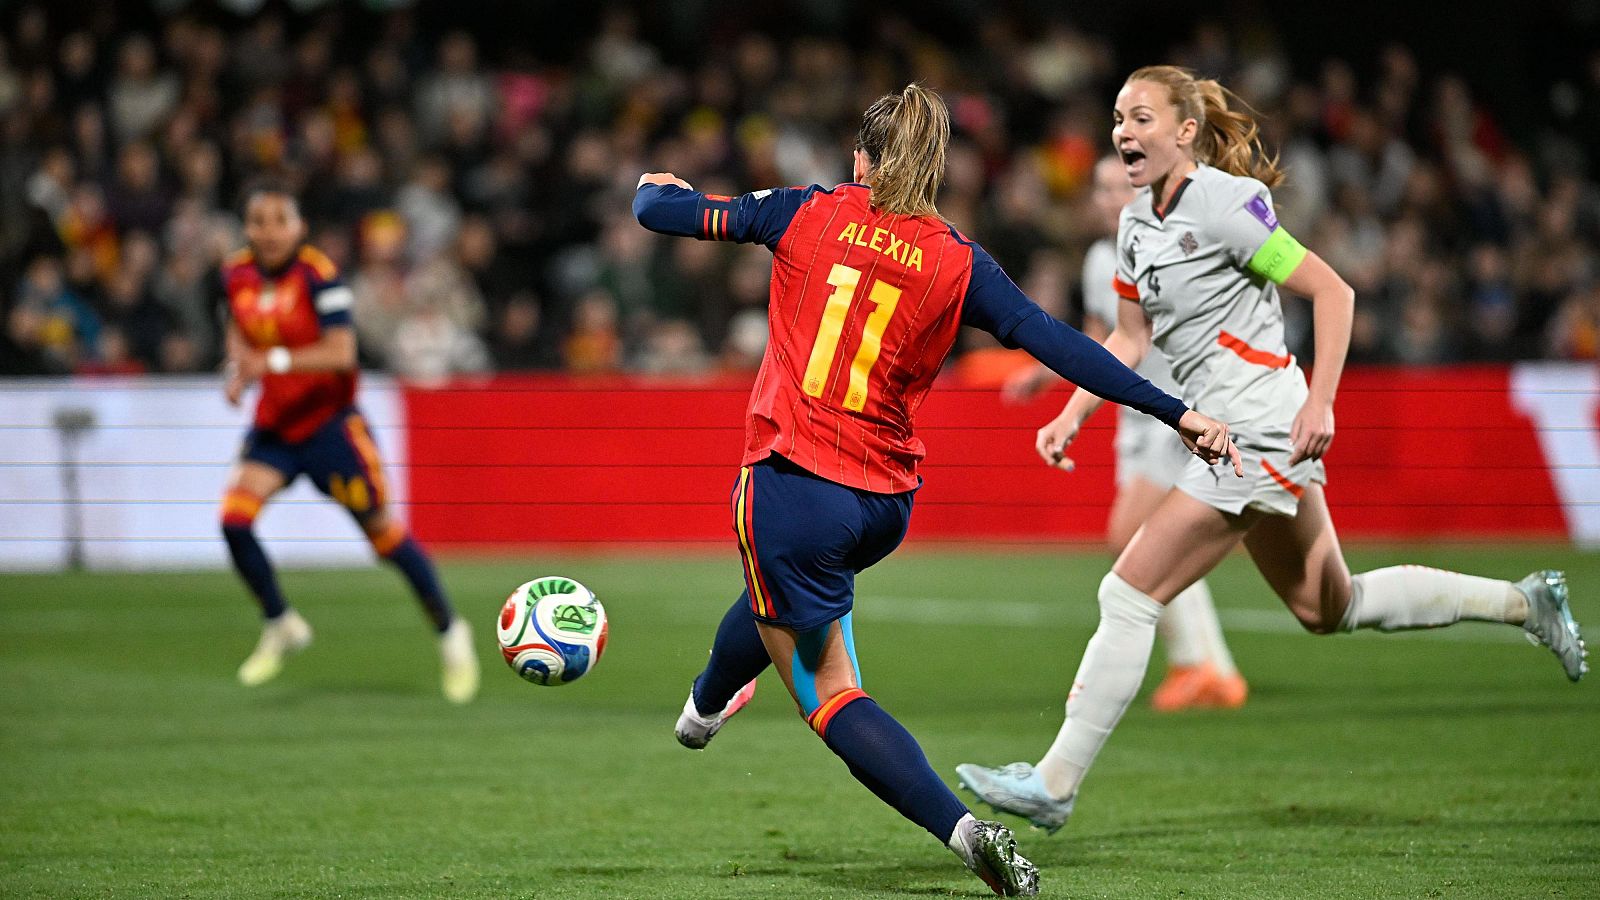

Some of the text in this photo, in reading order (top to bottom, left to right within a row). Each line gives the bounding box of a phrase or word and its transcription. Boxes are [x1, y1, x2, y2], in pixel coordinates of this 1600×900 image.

[837, 222, 924, 272] ALEXIA
[1147, 270, 1161, 297] 4
[801, 263, 903, 412] 11
